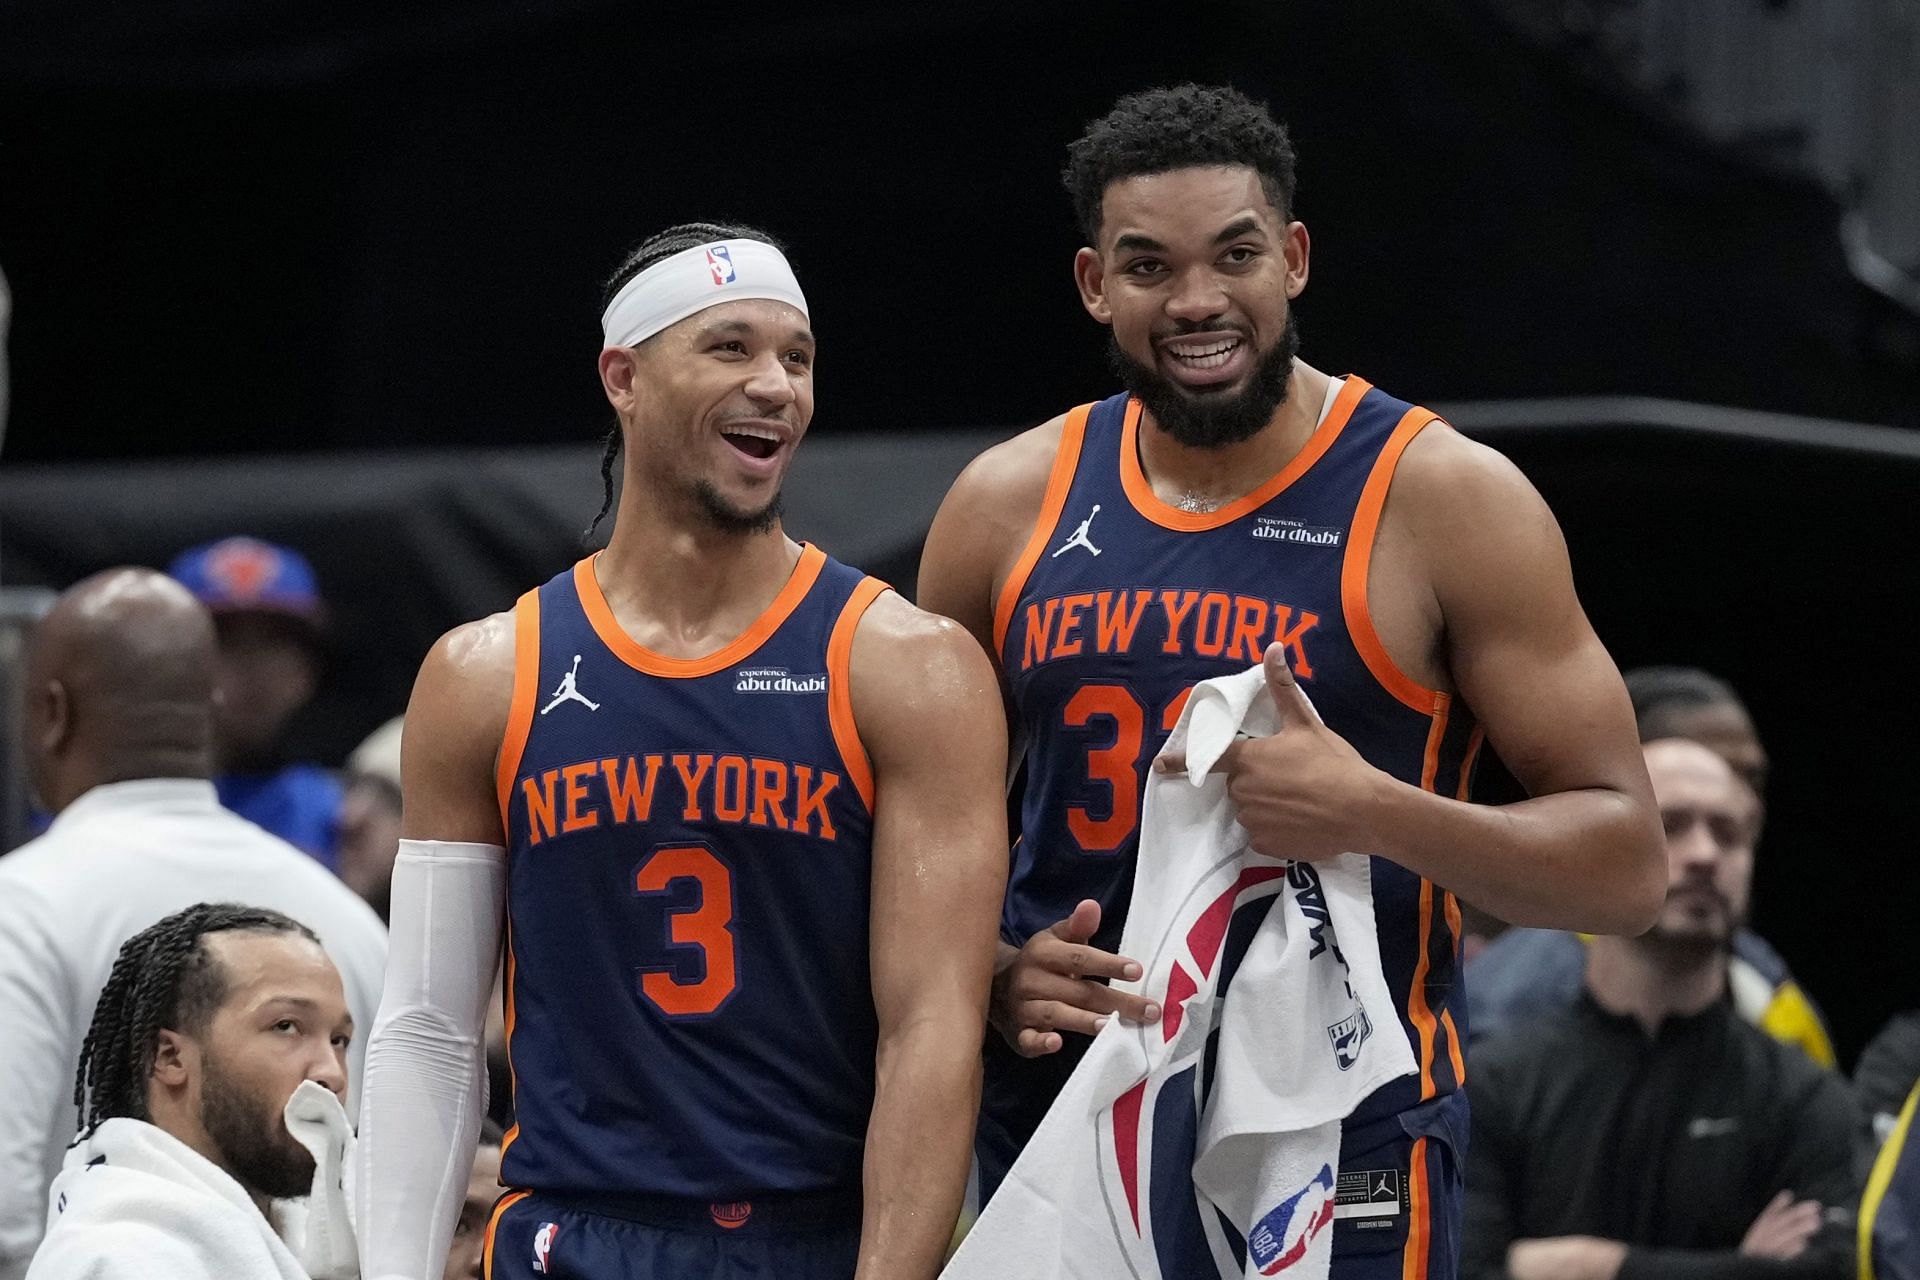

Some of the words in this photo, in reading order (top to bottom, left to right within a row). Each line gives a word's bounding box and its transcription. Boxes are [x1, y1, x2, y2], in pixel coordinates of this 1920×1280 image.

[1252, 525, 1287, 540] abu
[1288, 528, 1341, 545] dhabi
[1257, 517, 1305, 528] experience
[1021, 589, 1154, 672] NEW
[1160, 590, 1320, 681] YORK
[736, 677, 771, 691] abu
[773, 676, 827, 692] dhabi
[739, 669, 787, 678] experience
[521, 753, 663, 847] NEW
[670, 753, 841, 841] YORK
[636, 846, 736, 1015] 3
[1252, 1224, 1279, 1258] NBA
